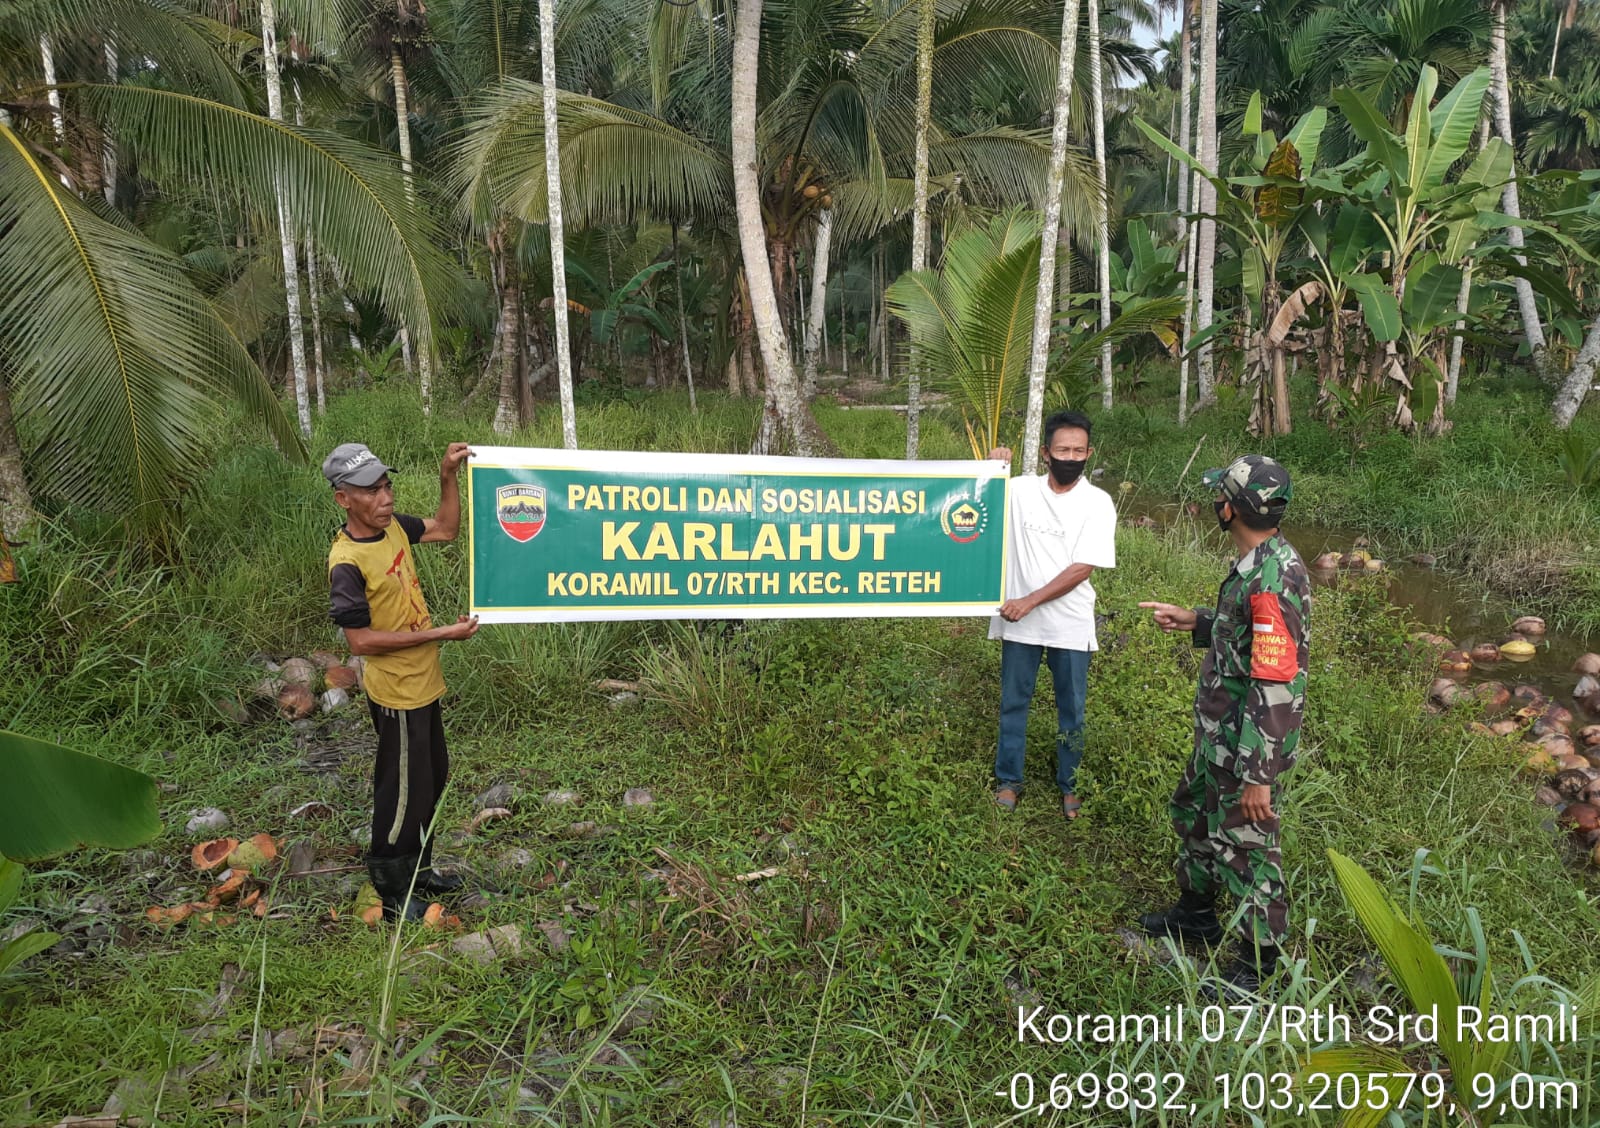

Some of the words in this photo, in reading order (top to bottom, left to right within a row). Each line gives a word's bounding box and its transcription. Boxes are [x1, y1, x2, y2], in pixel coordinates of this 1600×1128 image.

[567, 484, 687, 512] PATROLI
[697, 486, 753, 513] DAN
[761, 488, 927, 515] SOSIALISASI
[602, 521, 896, 561] KARLAHUT
[547, 572, 679, 596] KORAMIL
[687, 572, 780, 595] 07/RTH
[789, 571, 849, 594] KEC.
[858, 571, 941, 594] RETEH
